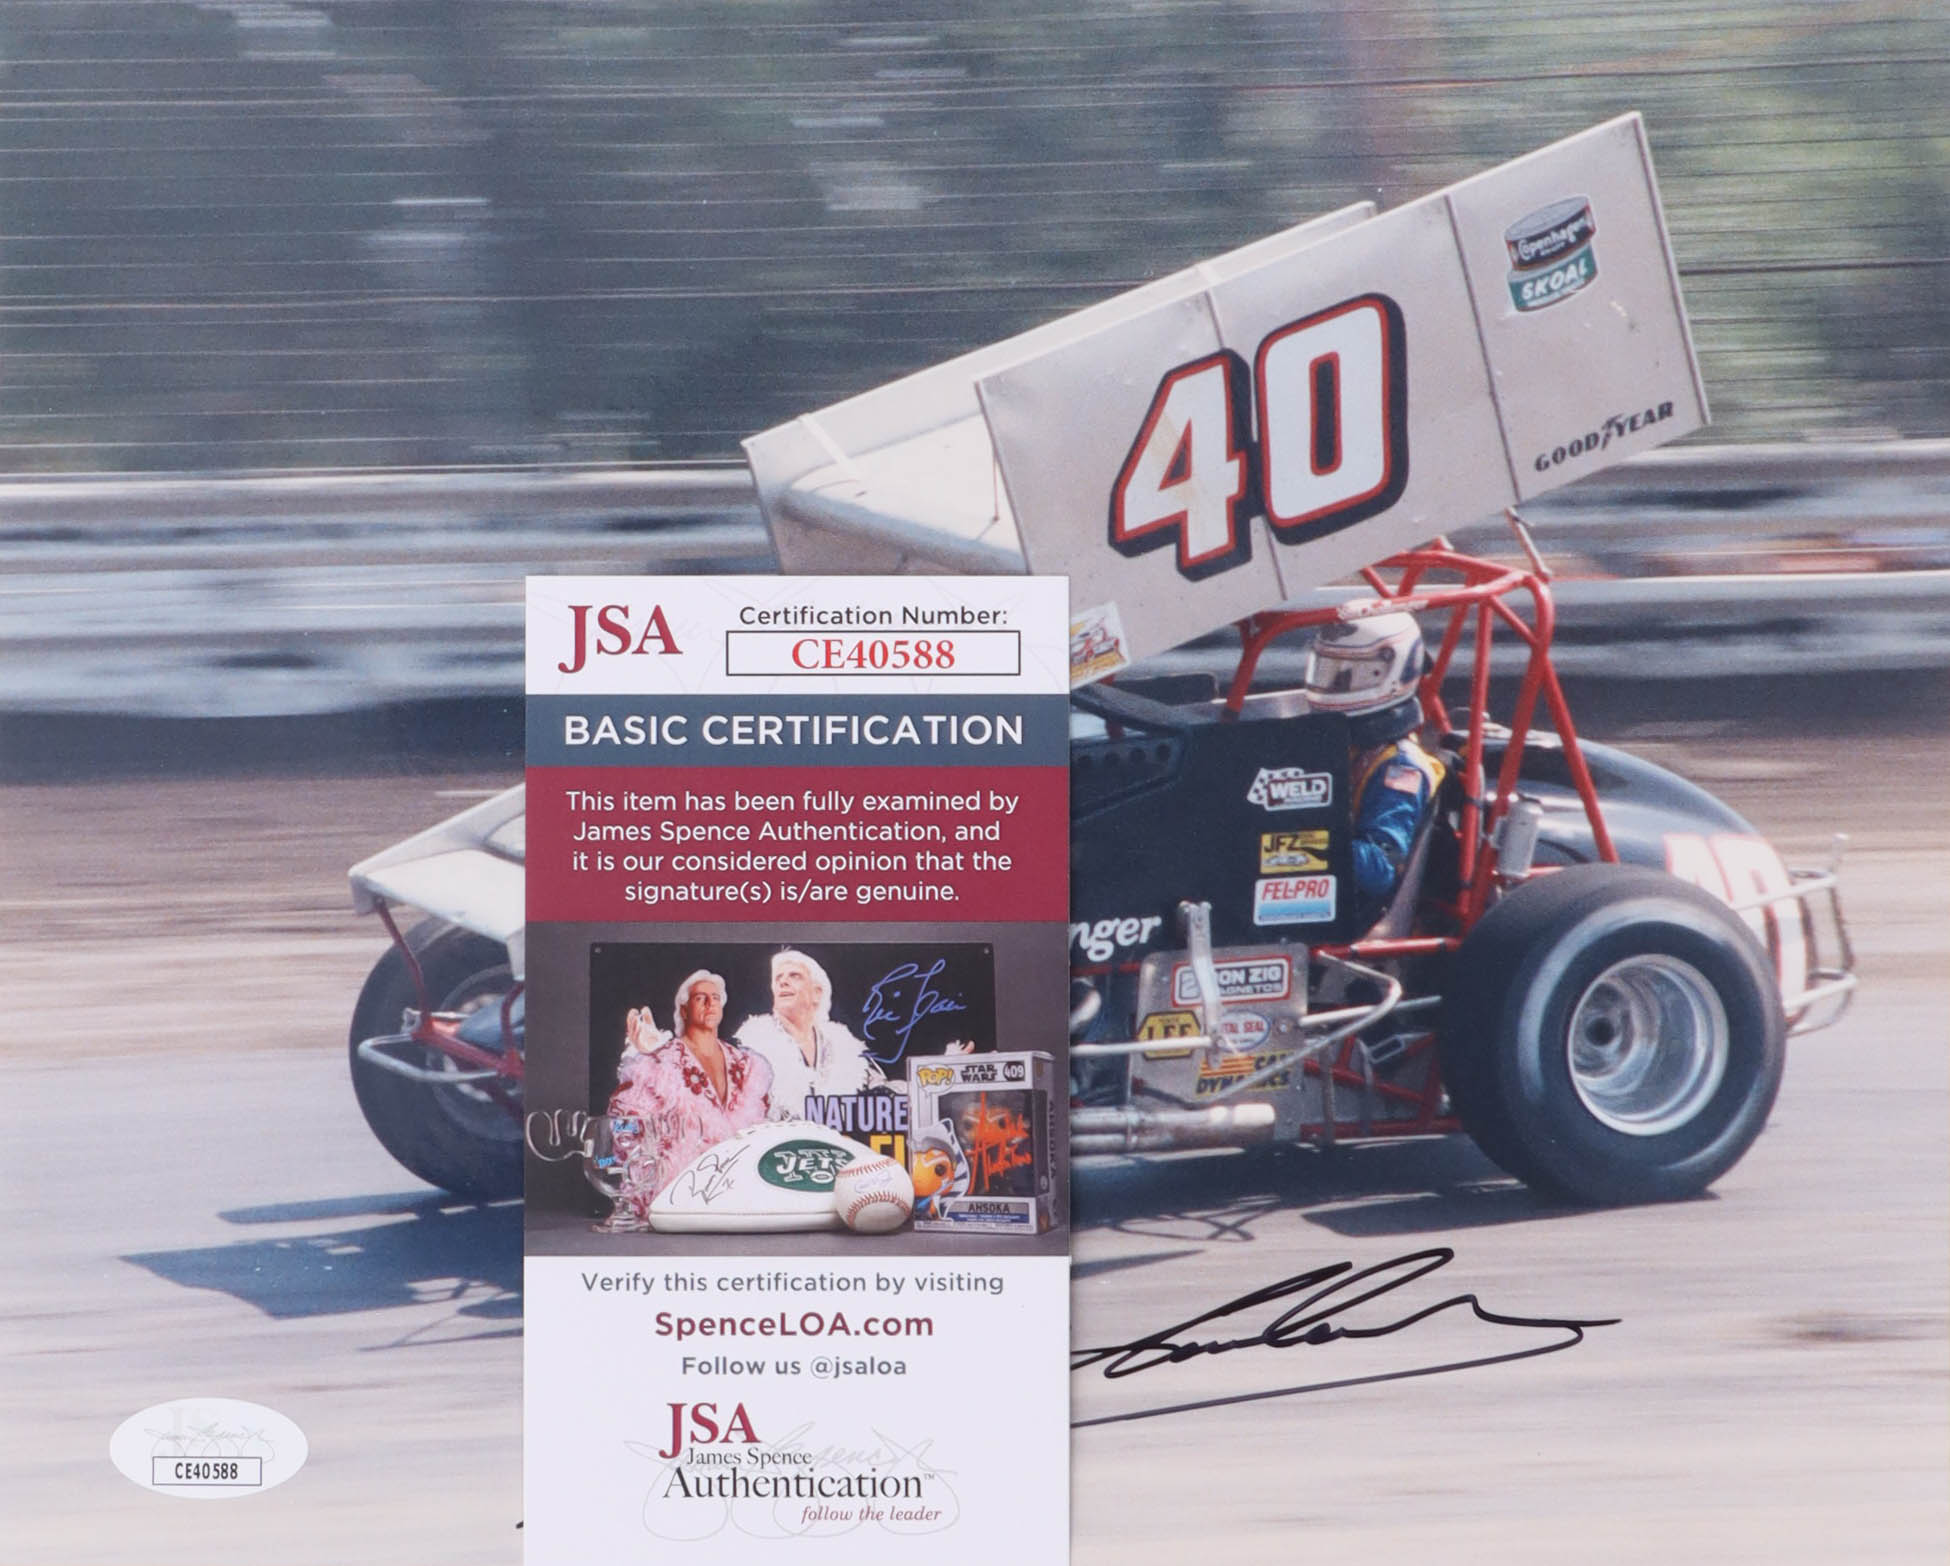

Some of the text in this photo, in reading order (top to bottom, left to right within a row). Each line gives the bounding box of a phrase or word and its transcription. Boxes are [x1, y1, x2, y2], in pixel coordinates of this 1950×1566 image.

[1521, 258, 1588, 300] SKOAL
[1107, 292, 1409, 582] 40
[1534, 401, 1674, 472] GOODYEAR
[739, 605, 1007, 625] Certification Number:
[557, 604, 684, 675] JSA
[791, 638, 956, 670] CE40588
[565, 714, 1023, 746] BASIC CERTIFICATION
[566, 789, 1019, 814] This item has been fully examined by
[1269, 779, 1327, 800] WELD
[573, 820, 1000, 845] James Spence Authentication, and
[1263, 835, 1300, 853] JFZ
[573, 850, 1012, 875] it is our considered opinion that the
[625, 879, 960, 905] signature(s) is/are genuine.
[917, 1067, 954, 1087] POP!
[960, 1071, 998, 1082] WARS
[964, 1064, 997, 1073] STAR
[1003, 1065, 1025, 1079] 409
[805, 1095, 909, 1132] NATURE
[968, 1202, 1010, 1213] AHSOKA
[581, 1272, 1004, 1296] Verify this certification by visiting
[655, 1311, 934, 1342] SpenceLOA.com
[682, 1356, 906, 1379] Follow us @jsaloa
[658, 1402, 761, 1459] JSA
[686, 1447, 812, 1468] James Spence
[174, 1462, 239, 1480] CE40588
[801, 1505, 942, 1524] follow the leader
